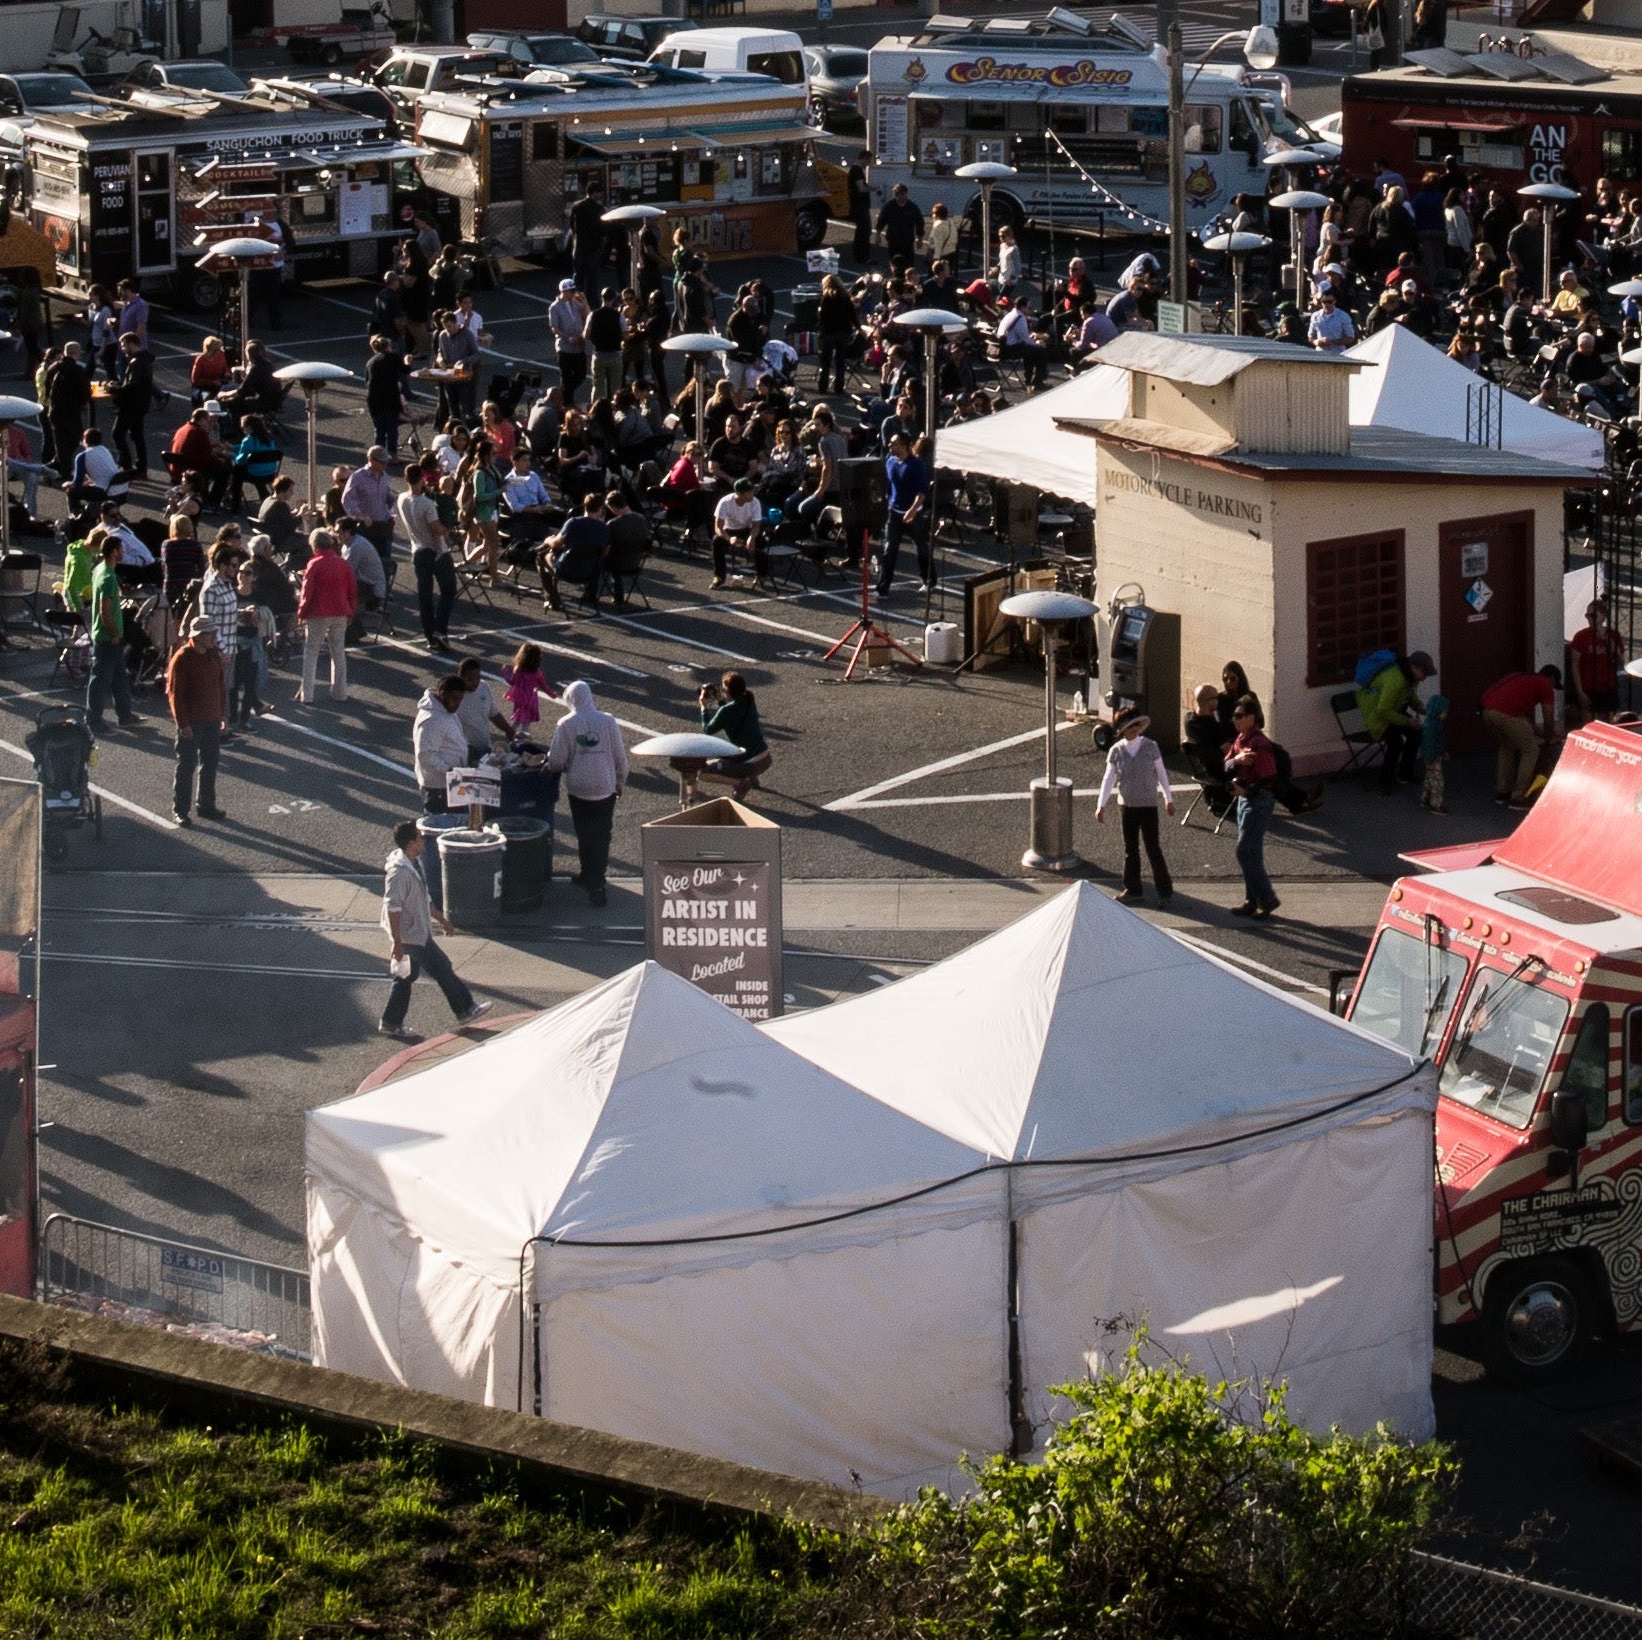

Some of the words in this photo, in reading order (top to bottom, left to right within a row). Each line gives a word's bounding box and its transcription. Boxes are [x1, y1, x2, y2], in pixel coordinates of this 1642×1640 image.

[1067, 60, 1132, 83] SISIG
[206, 136, 282, 152] SANGUCHON
[291, 132, 324, 145] FOOD
[326, 129, 365, 142] TRUCK
[1529, 124, 1566, 148] AN
[1533, 148, 1561, 162] THE
[93, 163, 131, 178] PERUVIAN
[102, 196, 124, 209] FOOD
[1105, 468, 1192, 506] MOTORCYCLE
[1197, 490, 1263, 524] PARKING
[661, 874, 690, 895] See
[692, 867, 724, 888] Our
[661, 899, 728, 920] ARTIST
[734, 900, 757, 920] IN
[662, 927, 768, 947] RESIDENCE
[690, 951, 745, 981] Located
[735, 980, 769, 992] INSIDE
[712, 994, 739, 1005] TAIL
[741, 994, 769, 1006] SHOP
[735, 1008, 769, 1019] RANCE
[1502, 1198, 1528, 1214] THE
[1532, 1187, 1599, 1210] CHAIRMAN
